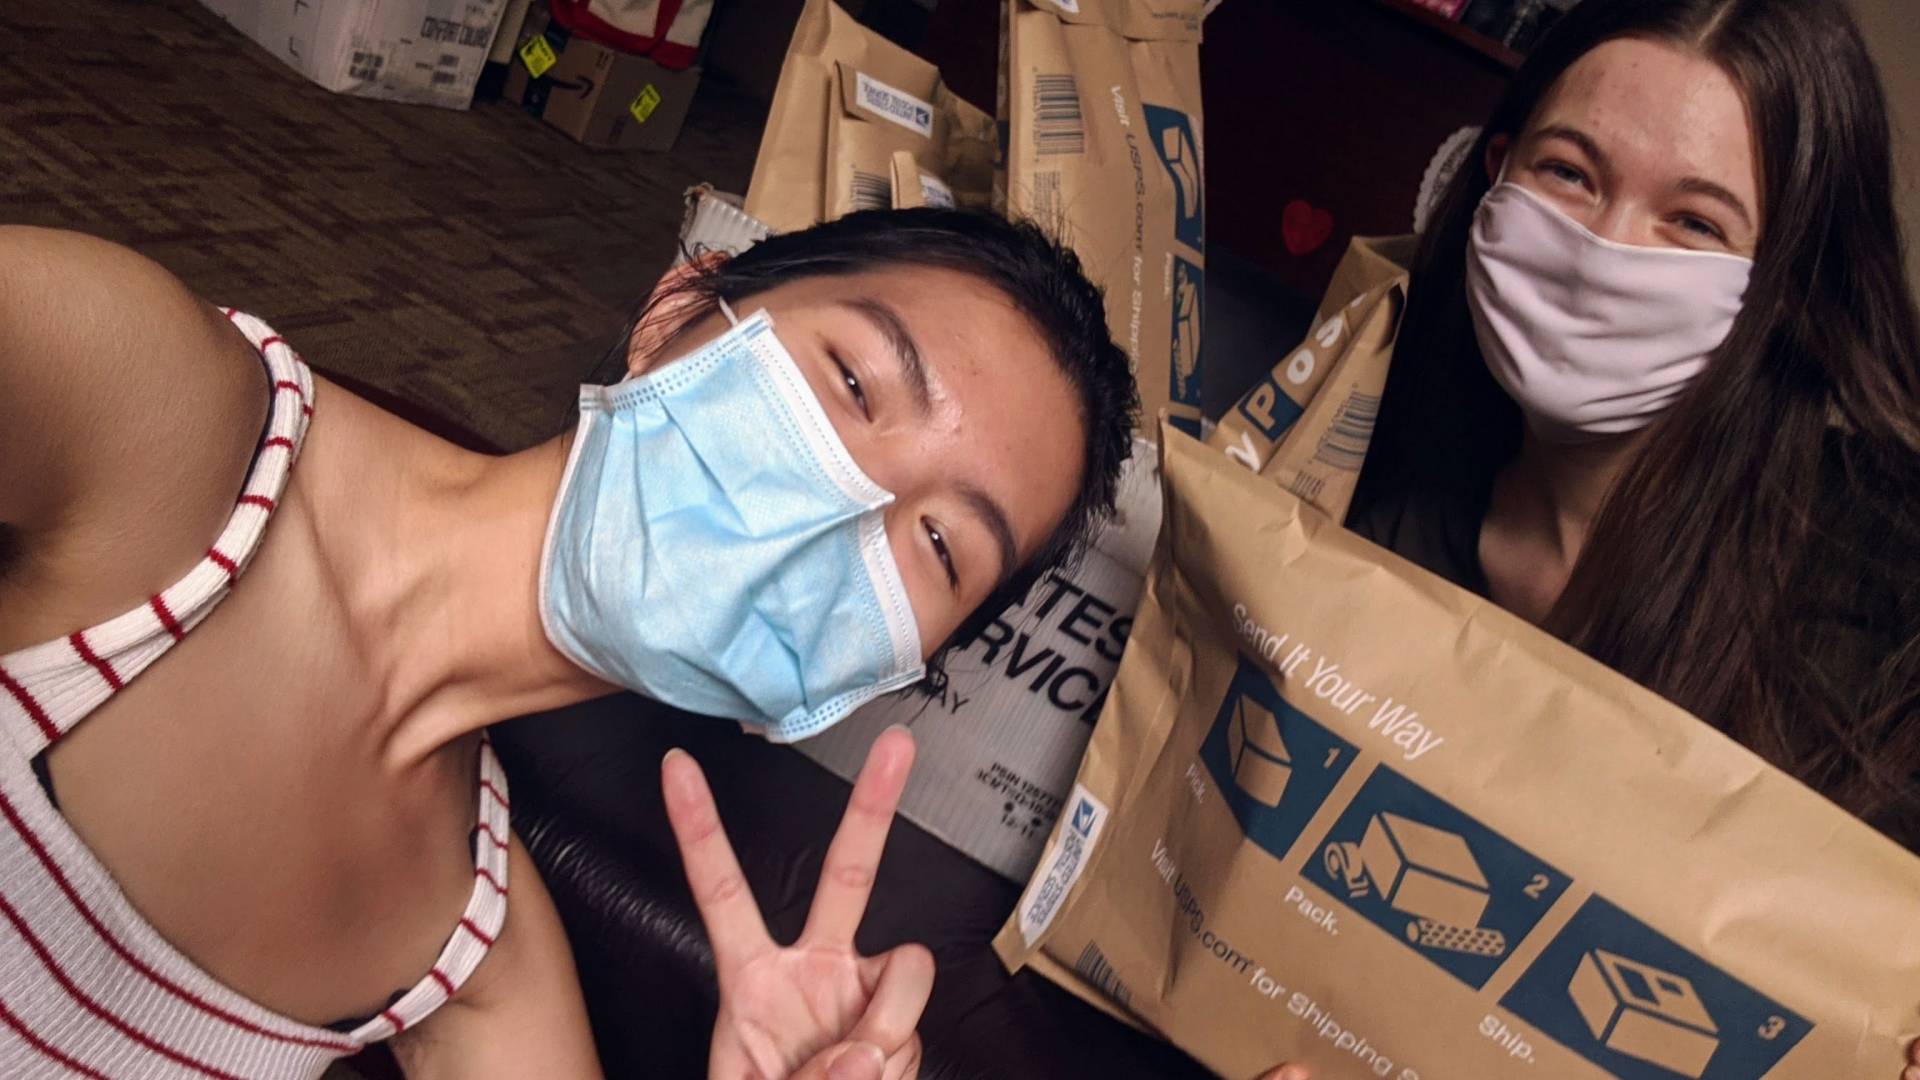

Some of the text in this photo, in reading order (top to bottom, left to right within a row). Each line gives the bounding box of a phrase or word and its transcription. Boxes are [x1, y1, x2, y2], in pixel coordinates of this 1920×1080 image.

[1133, 256, 1143, 285] for
[1233, 603, 1445, 761] Send It Your Way
[1322, 747, 1340, 769] 1
[1522, 873, 1549, 900] 2
[1283, 886, 1340, 936] Pack.
[1151, 838, 1176, 884] Visit
[1250, 967, 1287, 999] for
[1287, 991, 1394, 1077] Shipping
[1478, 1013, 1537, 1065] Ship.
[1757, 1015, 1787, 1041] 3
